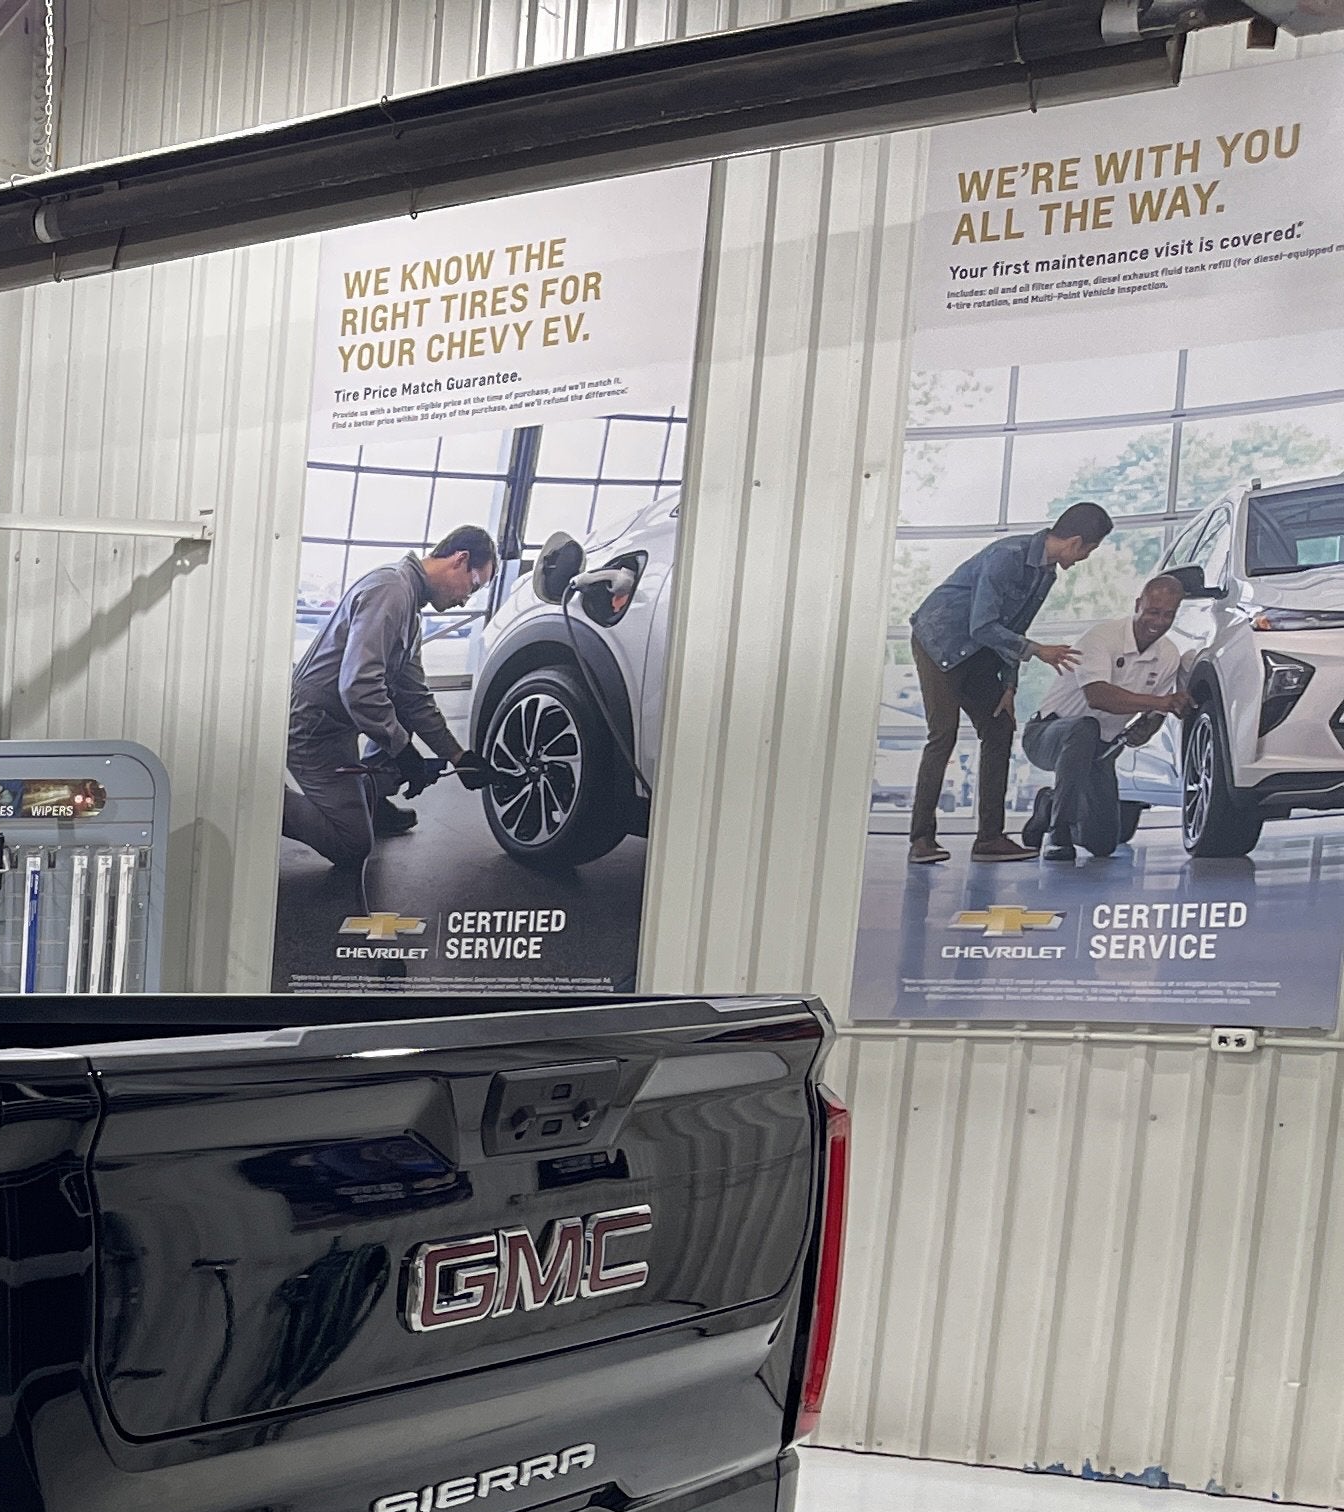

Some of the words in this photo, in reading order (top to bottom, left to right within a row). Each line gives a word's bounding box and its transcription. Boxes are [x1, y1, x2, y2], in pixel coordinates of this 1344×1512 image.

[1094, 139, 1201, 184] WITH
[1215, 123, 1302, 168] YOU
[951, 208, 1025, 246] ALL
[1038, 195, 1115, 236] THE
[1128, 180, 1226, 226] WAY.
[344, 266, 390, 299] WE
[400, 249, 494, 292] KNOW
[505, 237, 567, 276] THE
[947, 289, 987, 298] Includes:
[988, 286, 999, 296] oil
[1001, 285, 1018, 294] and
[1031, 282, 1055, 291] filter
[1056, 278, 1091, 290] change,
[1093, 274, 1121, 285] diesel
[1122, 268, 1159, 282] exhaust
[1161, 265, 1183, 277] fluid
[1185, 263, 1206, 274] tank
[1208, 259, 1231, 271] refill
[1233, 257, 1251, 269] (for
[1254, 244, 1334, 265] diesel-equipped
[949, 265, 988, 281] Your
[992, 260, 1030, 277] first
[1035, 247, 1149, 273] maintenance
[1154, 240, 1193, 259] visit
[1199, 237, 1214, 253] is
[340, 298, 431, 336] RIGHT
[440, 283, 529, 323] TIRES
[540, 271, 602, 309] FOR
[947, 301, 972, 310] 4-tire
[973, 298, 1011, 308] rotation,
[1013, 296, 1029, 305] and
[1082, 287, 1116, 298] Vehicle
[338, 338, 415, 373] YOUR
[427, 320, 534, 363] CHEVY
[542, 312, 590, 348] EV.
[332, 411, 359, 419] Provide
[370, 408, 385, 416] with
[392, 404, 414, 414] better
[416, 402, 442, 412] eligible
[443, 400, 462, 409] price
[472, 395, 485, 404] the
[504, 391, 513, 400] of
[514, 387, 551, 400] purchase,
[552, 384, 567, 394] and
[587, 378, 612, 388] match
[334, 389, 360, 404] Tire
[363, 385, 398, 401] Price
[401, 378, 442, 396] Match
[446, 371, 522, 391] Guarantee.
[332, 421, 347, 430] Find
[430, 411, 447, 422] days
[448, 409, 457, 418] of
[458, 407, 470, 416] the
[471, 402, 508, 417] purchase,
[509, 401, 523, 411] and
[543, 395, 569, 406] refund
[570, 393, 583, 402] the
[31, 805, 74, 817] WIPERS
[447, 909, 567, 934] CERTIFIED
[1092, 901, 1247, 929] CERTIFIED
[335, 946, 429, 960] CHEVROLET
[445, 936, 543, 960] SERVICE
[941, 945, 1066, 959] CHEVROLET
[1089, 934, 1217, 960] SERVICE
[408, 1204, 652, 1333] GMC
